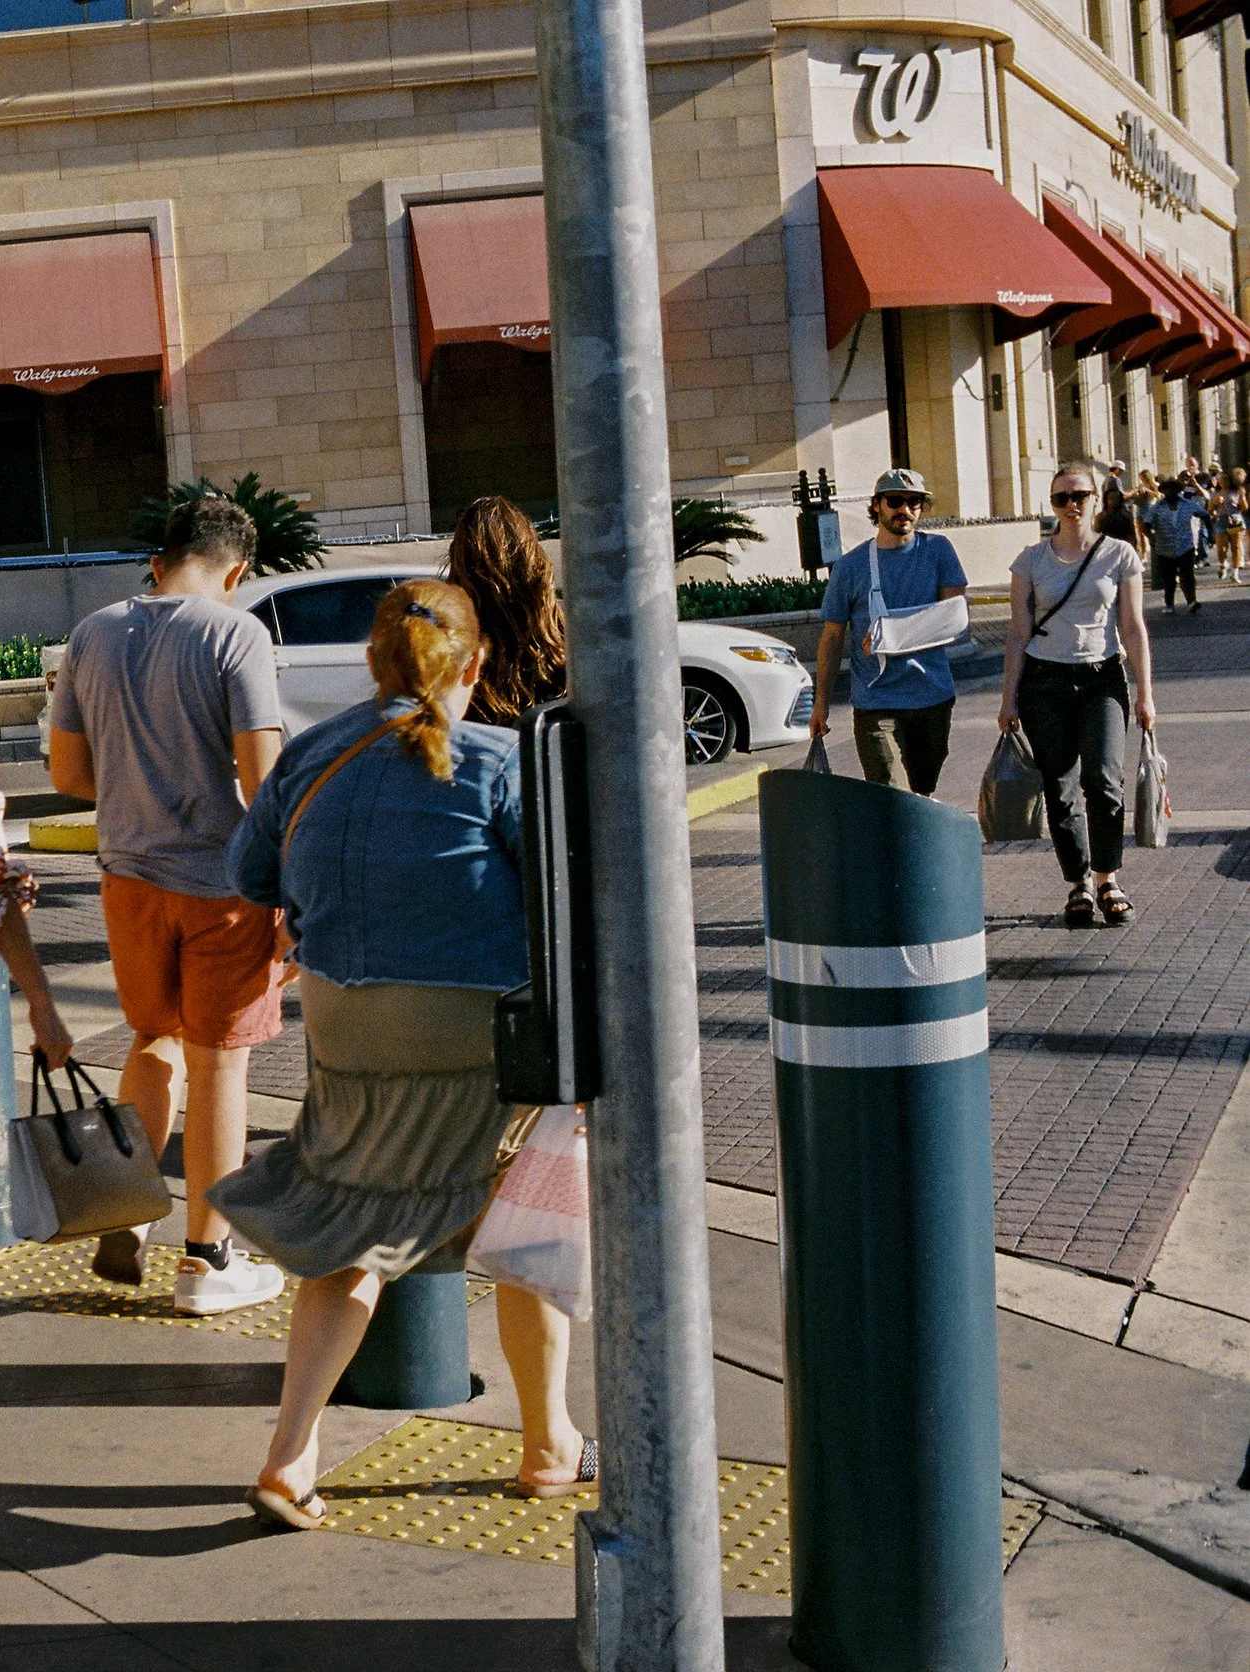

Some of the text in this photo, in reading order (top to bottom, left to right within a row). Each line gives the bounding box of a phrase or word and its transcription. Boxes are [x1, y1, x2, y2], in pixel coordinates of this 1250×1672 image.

[857, 46, 952, 140] W
[498, 324, 552, 340] Walgr
[12, 365, 100, 383] Walgreens
